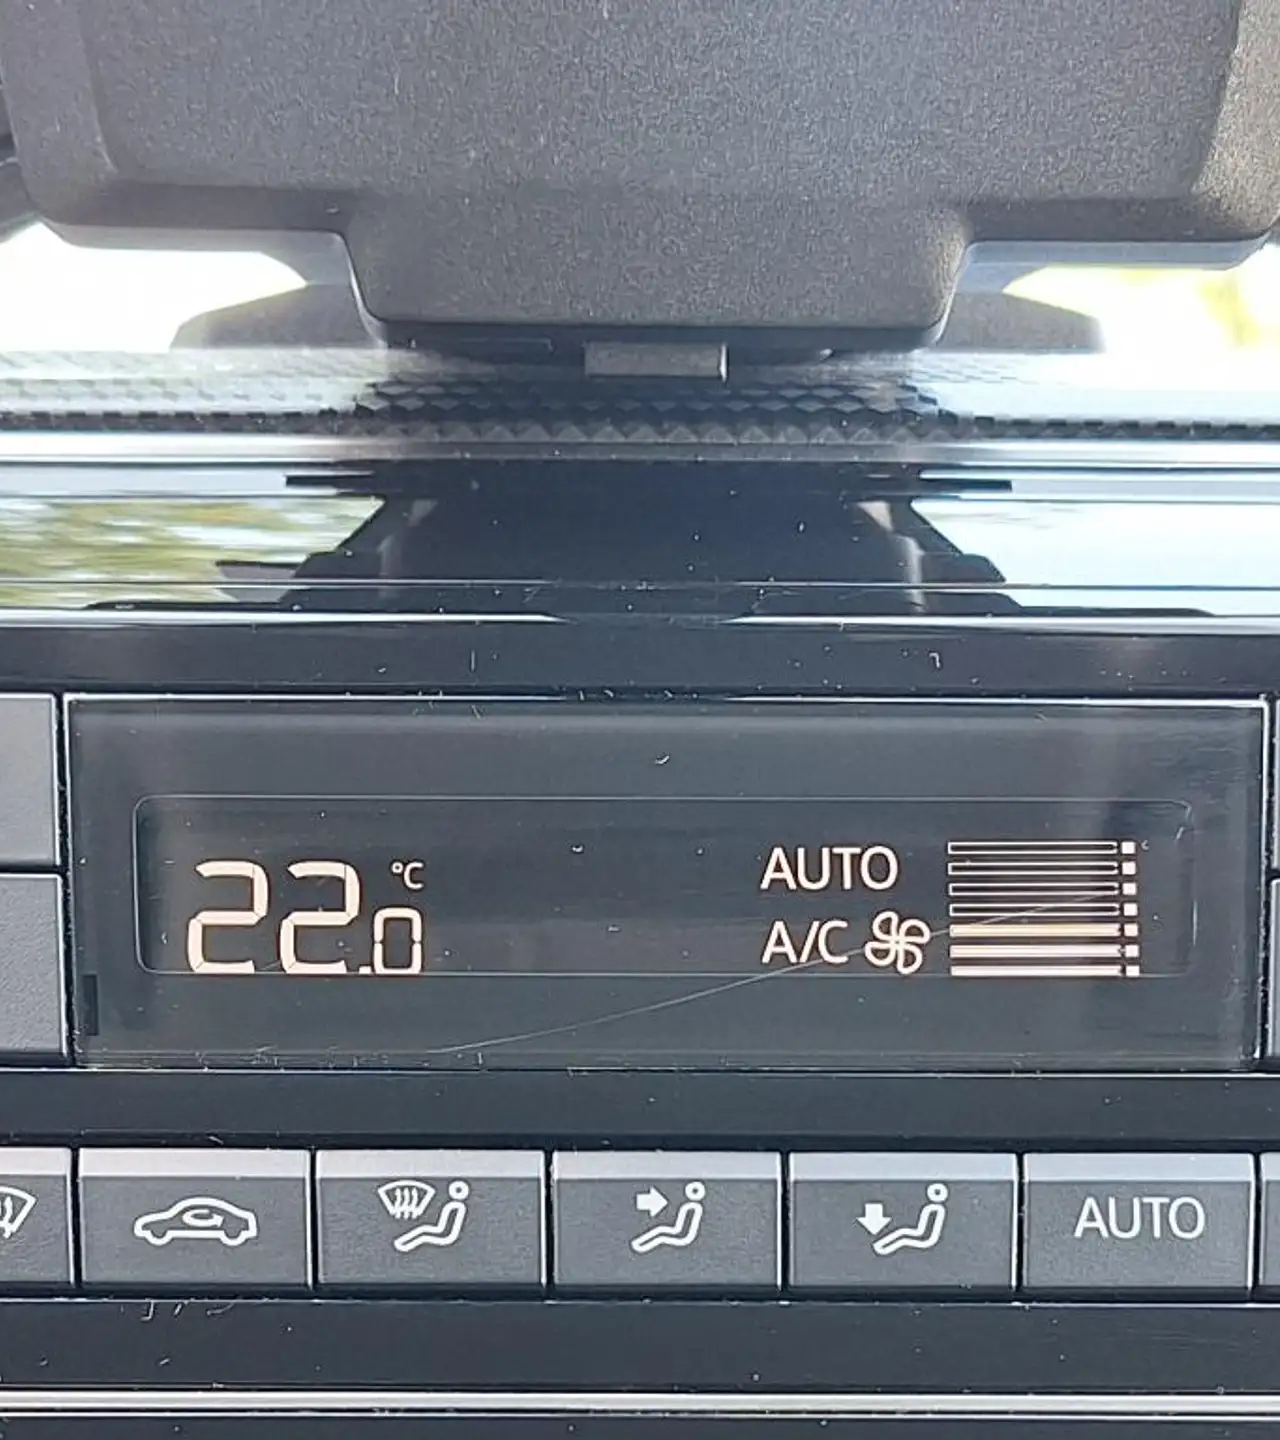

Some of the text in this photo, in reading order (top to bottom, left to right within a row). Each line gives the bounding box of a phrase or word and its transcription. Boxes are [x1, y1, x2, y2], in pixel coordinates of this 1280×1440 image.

[760, 845, 898, 890] AUTO
[187, 860, 423, 975] 22.0
[761, 920, 849, 964] A/C
[1073, 1196, 1206, 1239] AUTO
